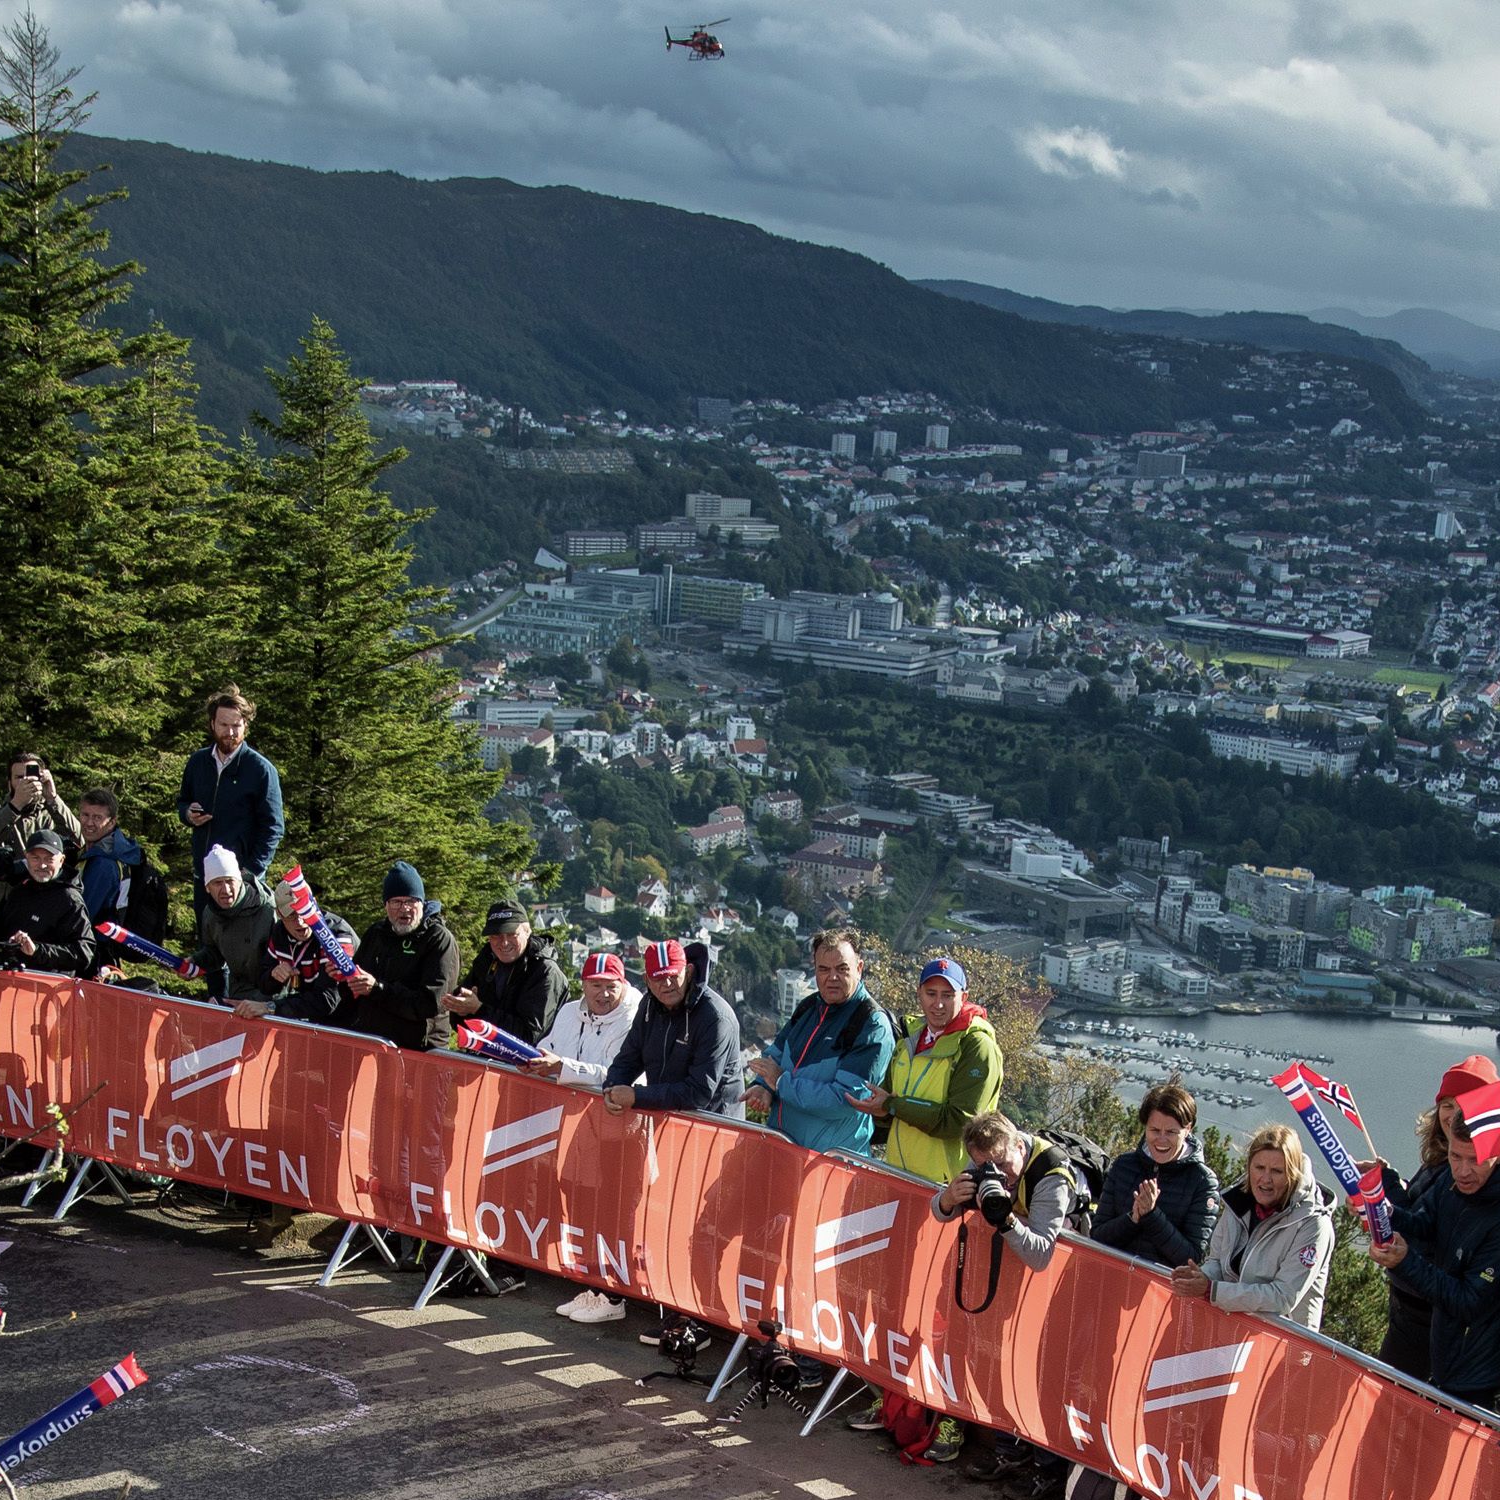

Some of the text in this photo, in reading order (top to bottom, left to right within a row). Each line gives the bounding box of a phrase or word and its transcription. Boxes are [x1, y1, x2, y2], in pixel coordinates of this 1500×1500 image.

[107, 1108, 312, 1199] FLØYEN
[410, 1181, 630, 1287] FLØYEN
[737, 1273, 960, 1404] FLØYEN
